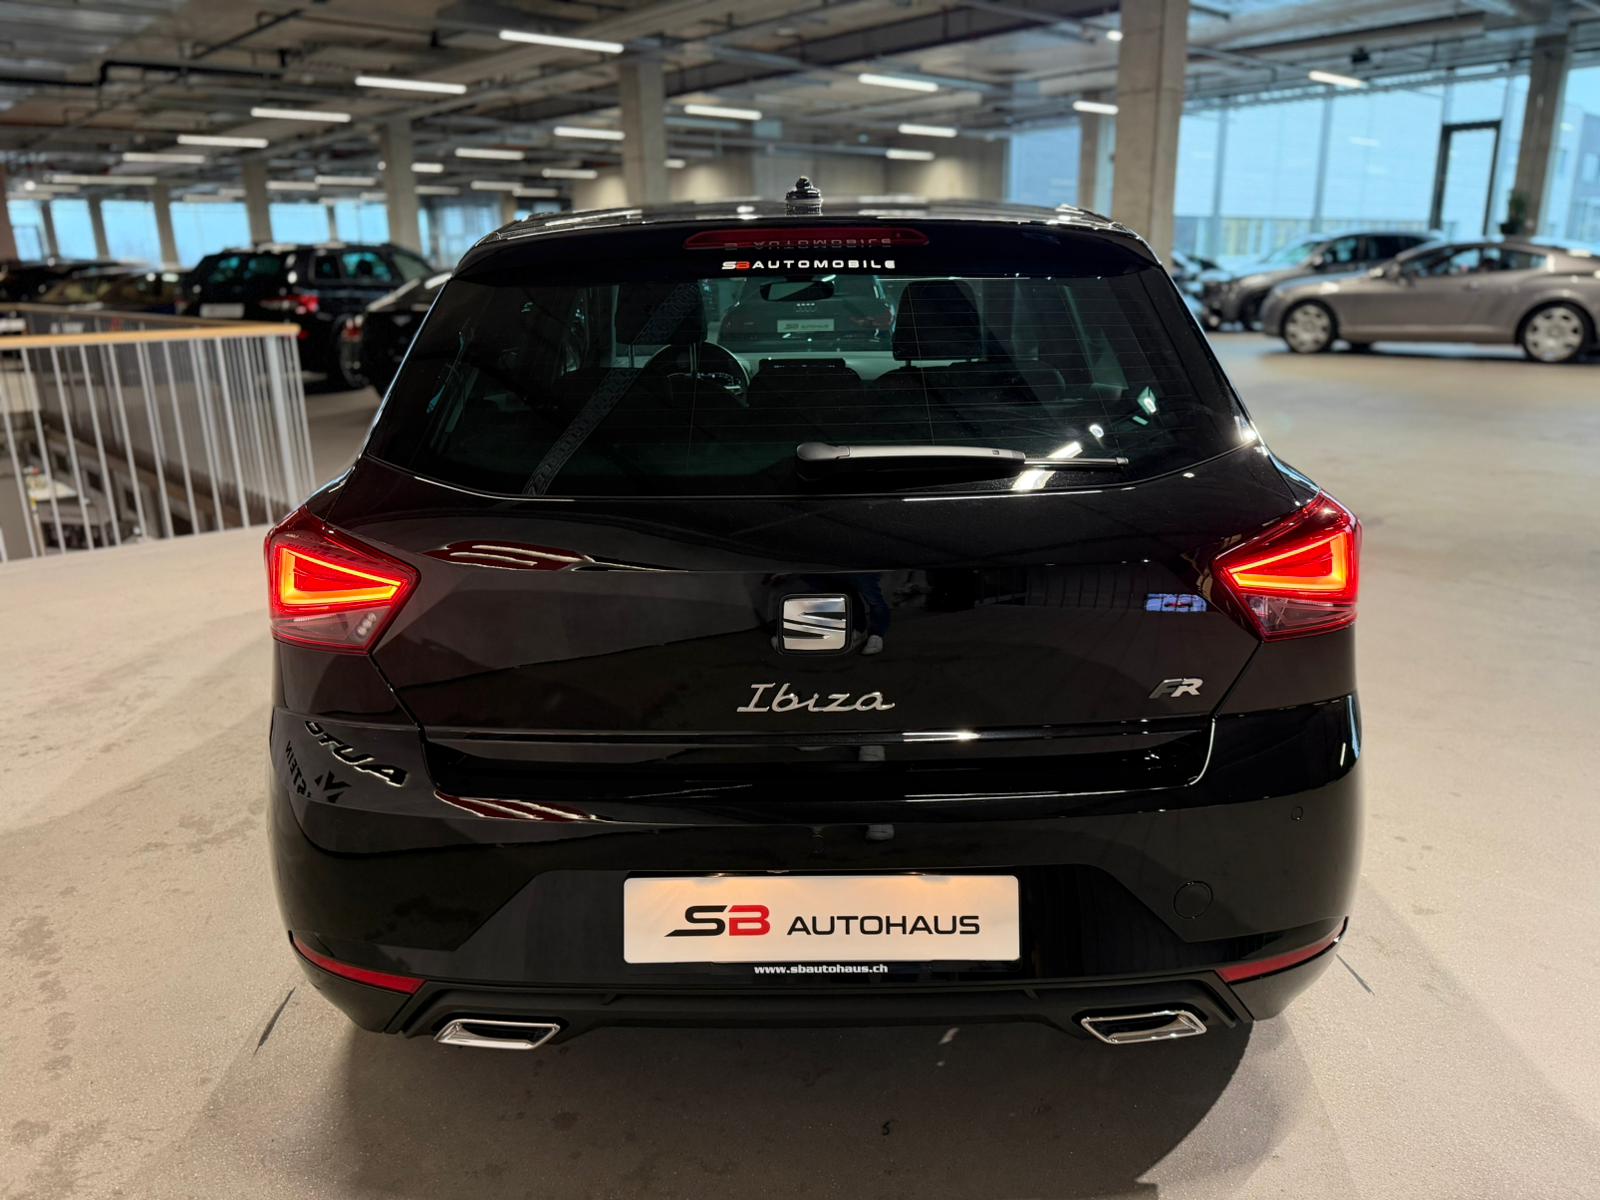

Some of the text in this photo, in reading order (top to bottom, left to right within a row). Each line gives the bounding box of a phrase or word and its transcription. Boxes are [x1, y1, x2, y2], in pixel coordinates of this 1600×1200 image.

[736, 682, 896, 713] Ibiza
[1149, 677, 1204, 699] FR
[665, 904, 981, 937] SB AUTOHAUS
[754, 963, 889, 975] www.sbautohaus.ch
